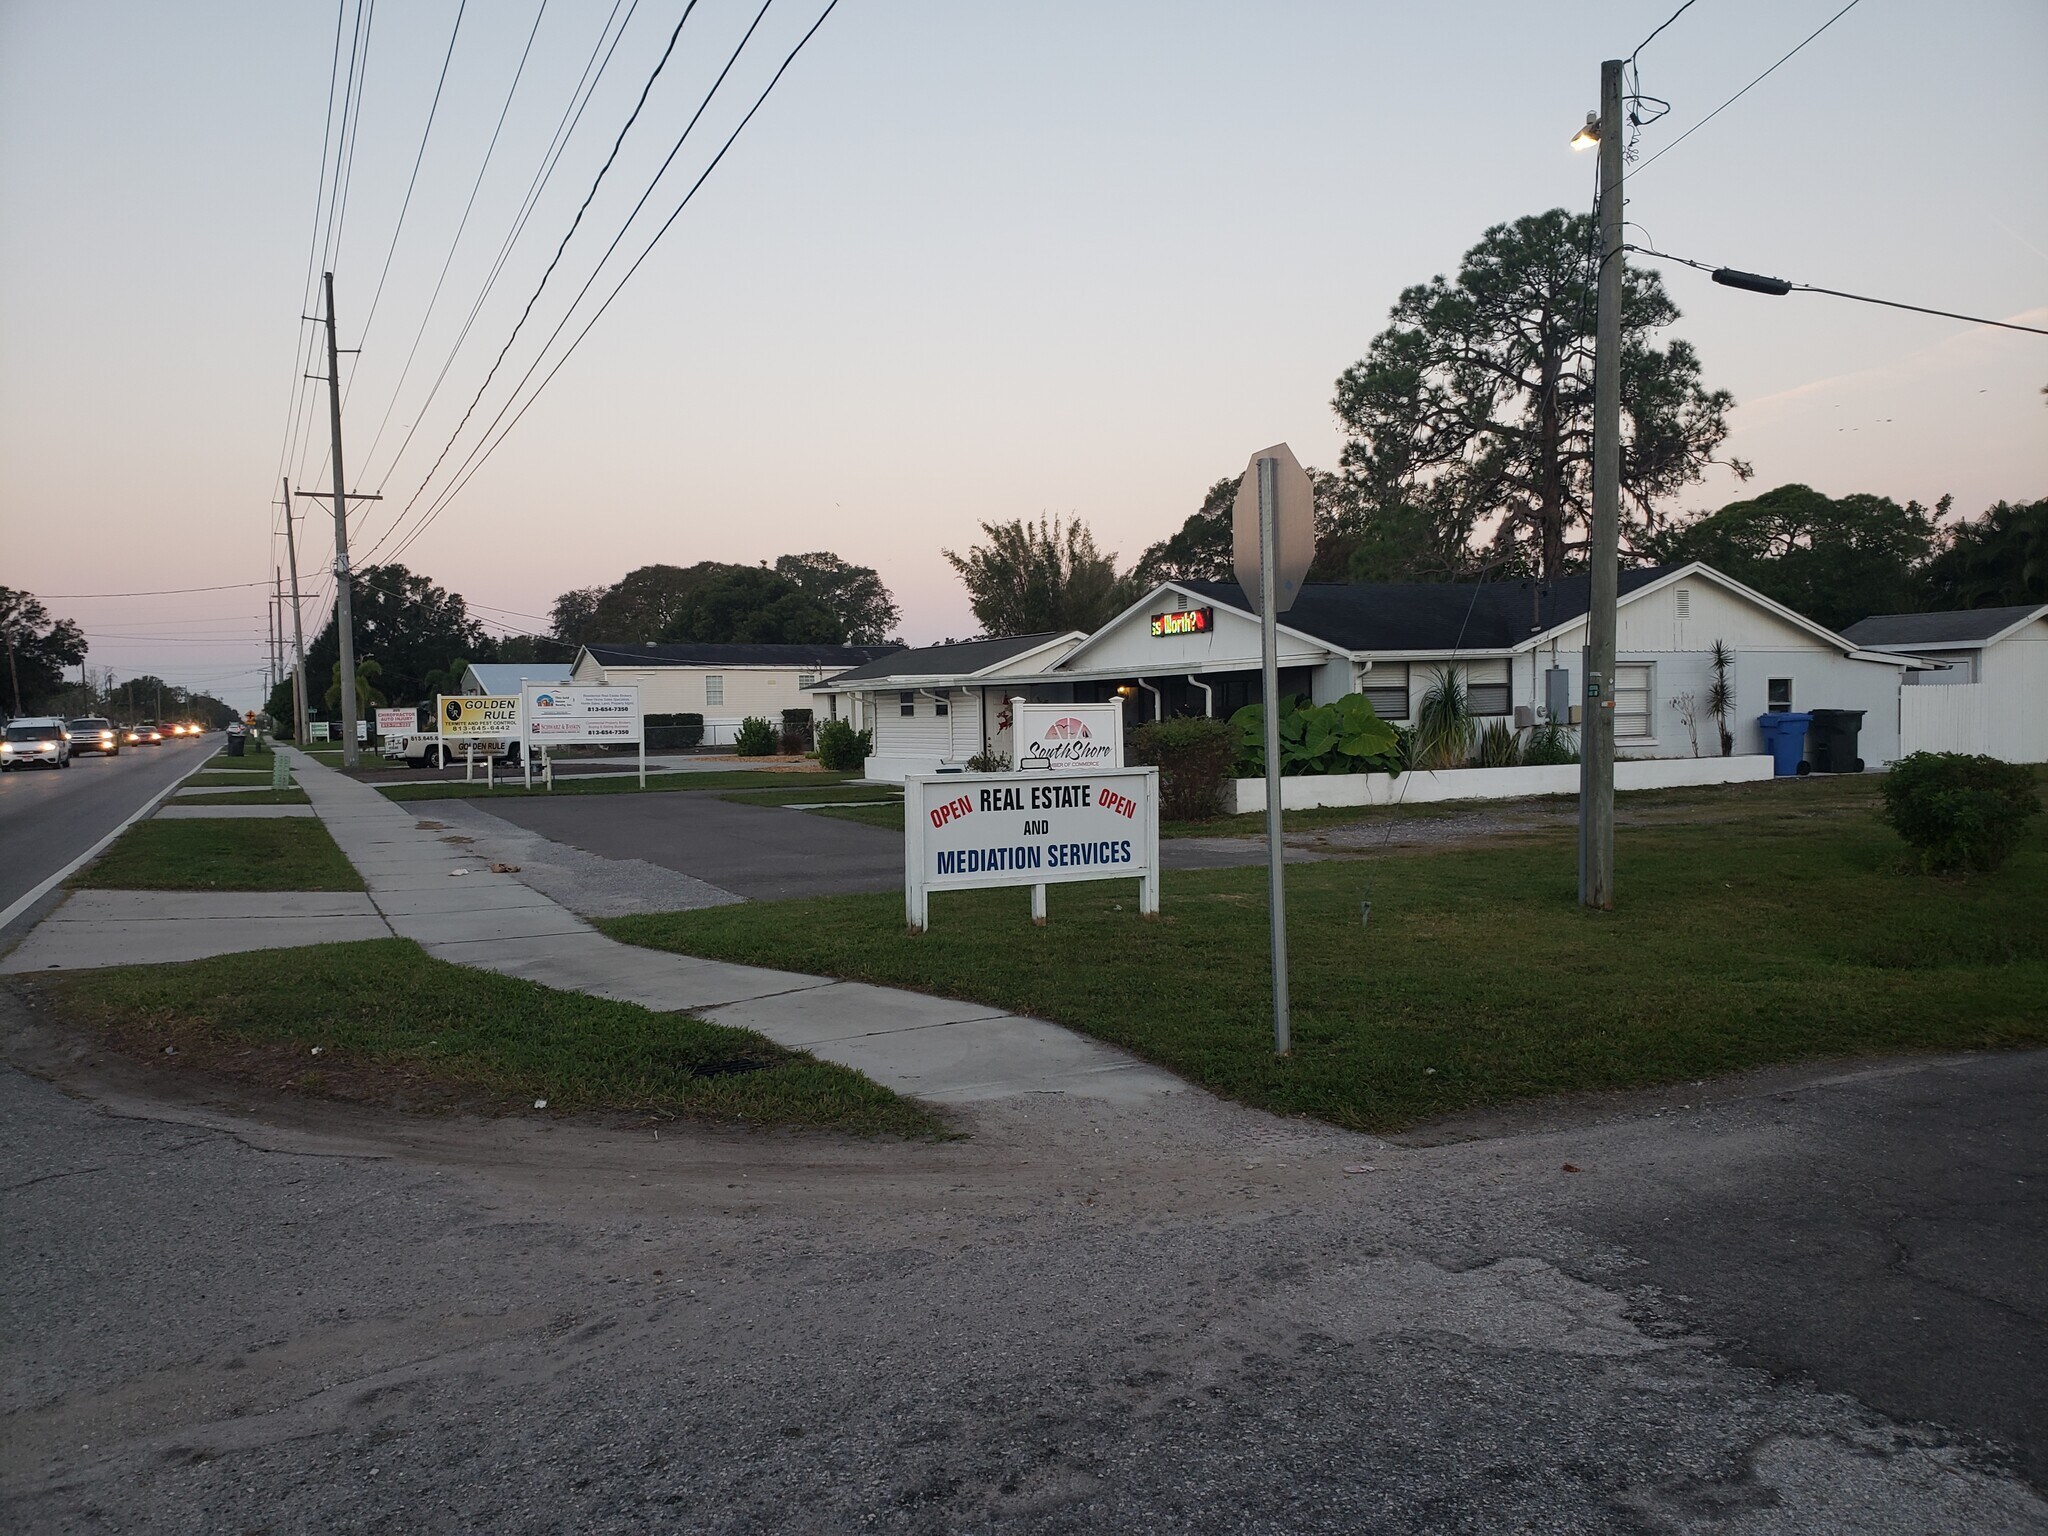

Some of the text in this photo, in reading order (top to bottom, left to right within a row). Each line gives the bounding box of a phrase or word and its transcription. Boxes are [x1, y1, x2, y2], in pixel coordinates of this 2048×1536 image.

[465, 700, 516, 709] GOLDEN
[484, 711, 516, 719] RULE
[930, 795, 973, 829] OPEN
[980, 785, 1091, 812] REAL ESTATE
[1098, 788, 1136, 819] OPEN
[1024, 820, 1049, 836] AND
[937, 840, 1131, 875] MEDIATION SERVICES
